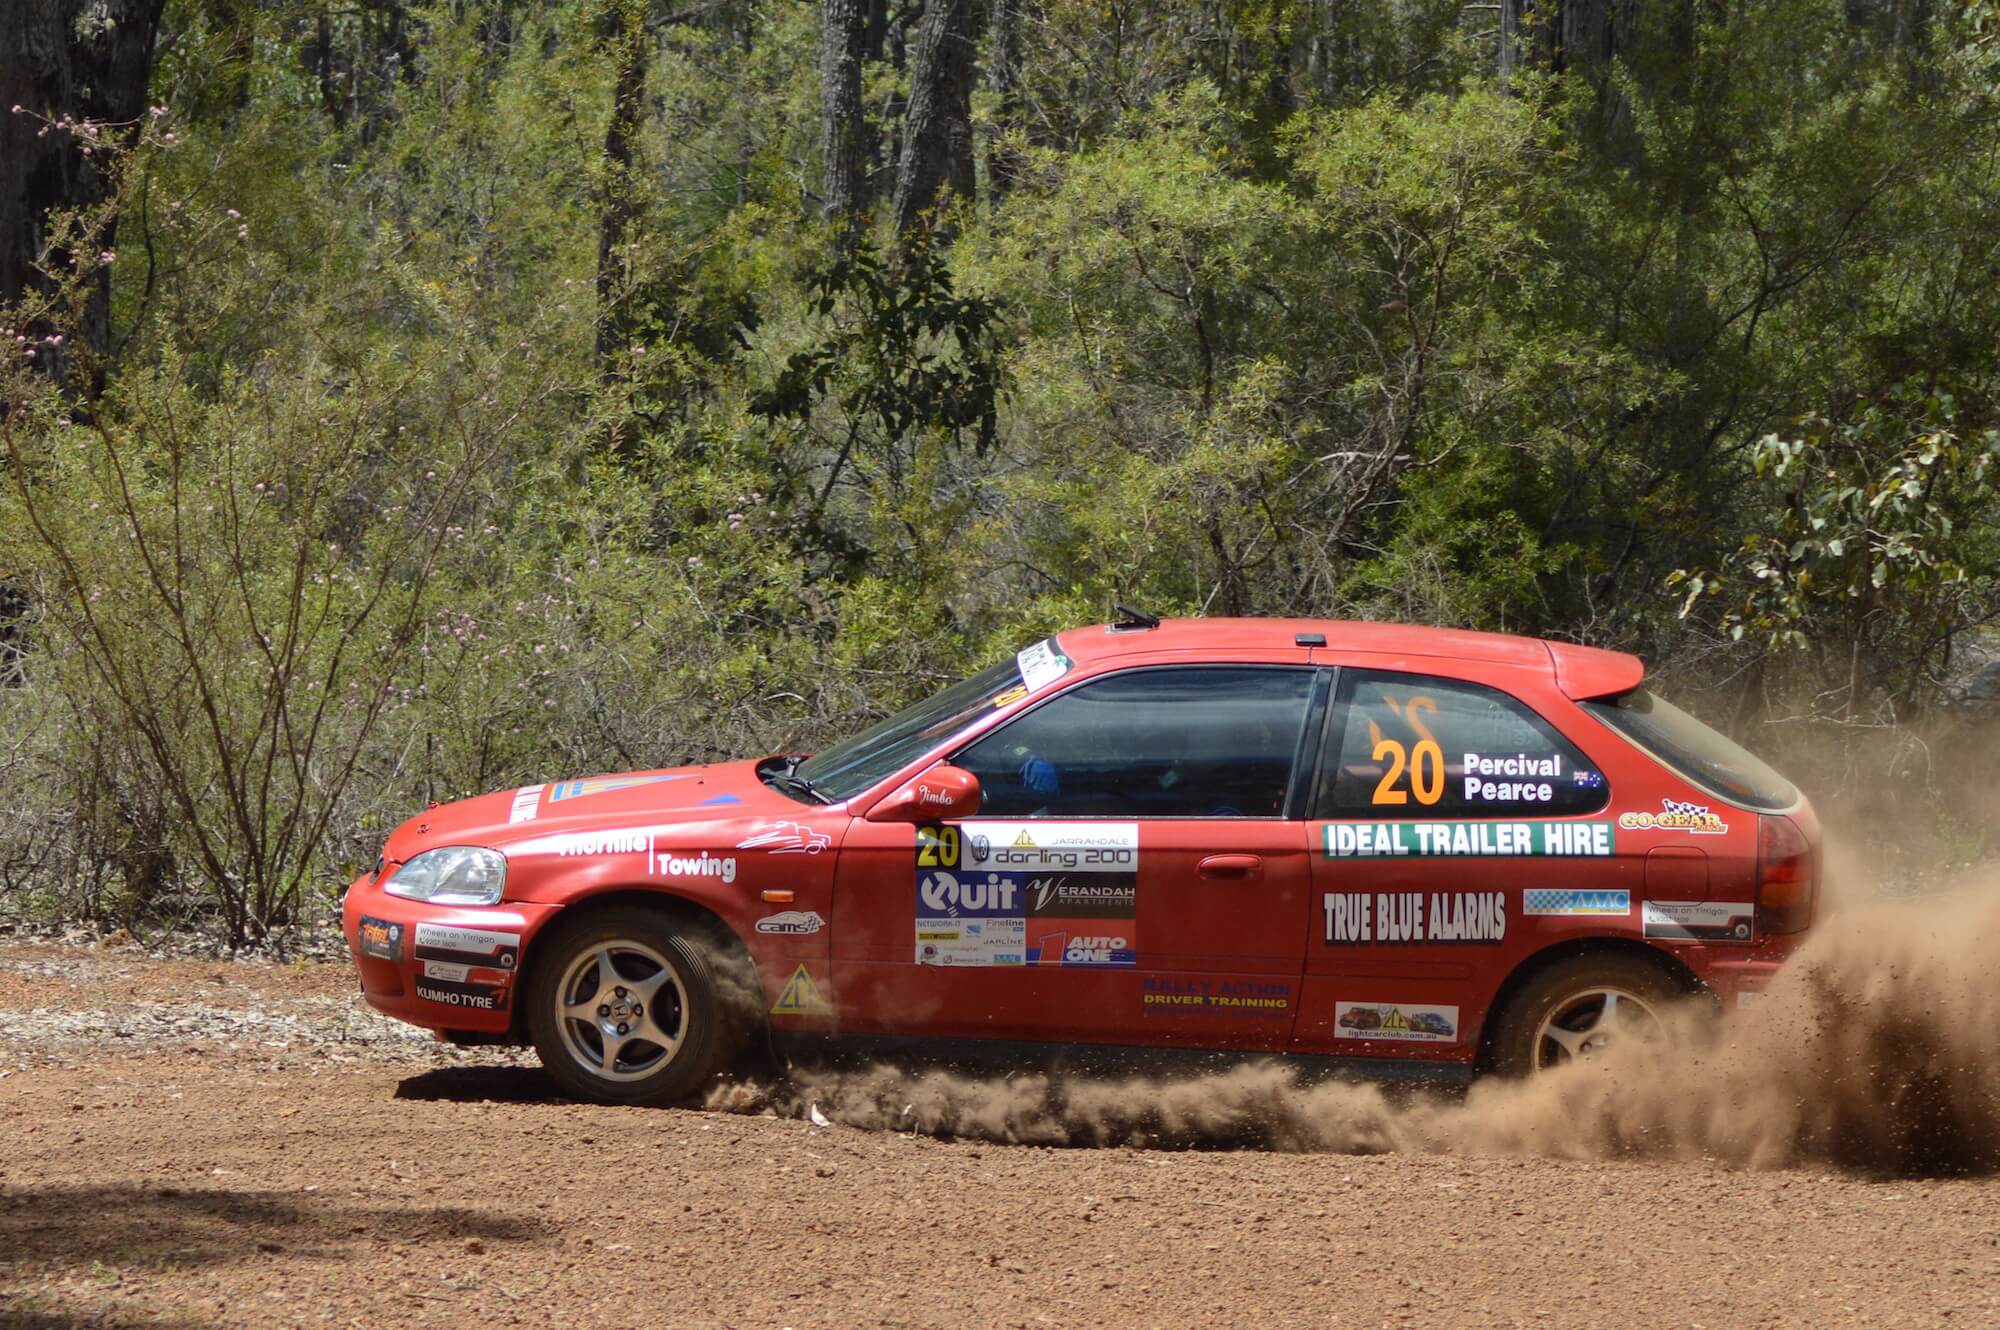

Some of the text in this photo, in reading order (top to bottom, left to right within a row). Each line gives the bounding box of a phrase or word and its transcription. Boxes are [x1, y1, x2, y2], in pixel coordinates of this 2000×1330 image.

[1372, 740, 1445, 805] 20
[1464, 752, 1561, 776] Percival
[1464, 777, 1553, 801] Pearce
[917, 826, 959, 867] 20
[1052, 837, 1129, 845] JARRAHDALE
[1327, 823, 1610, 856] IDEAL TRAILER HIRE
[657, 851, 737, 883] Towing
[995, 848, 1131, 867] darling 200
[921, 871, 1017, 917] Quit
[1324, 891, 1506, 941] TRUE BLUE ALARMS
[420, 927, 447, 938] Wheels
[1067, 936, 1127, 949] AUTO
[1066, 949, 1112, 961] ONE
[416, 985, 494, 1009] KUMHO TYRE
[1144, 994, 1288, 1008] DRIVER TRAINING
